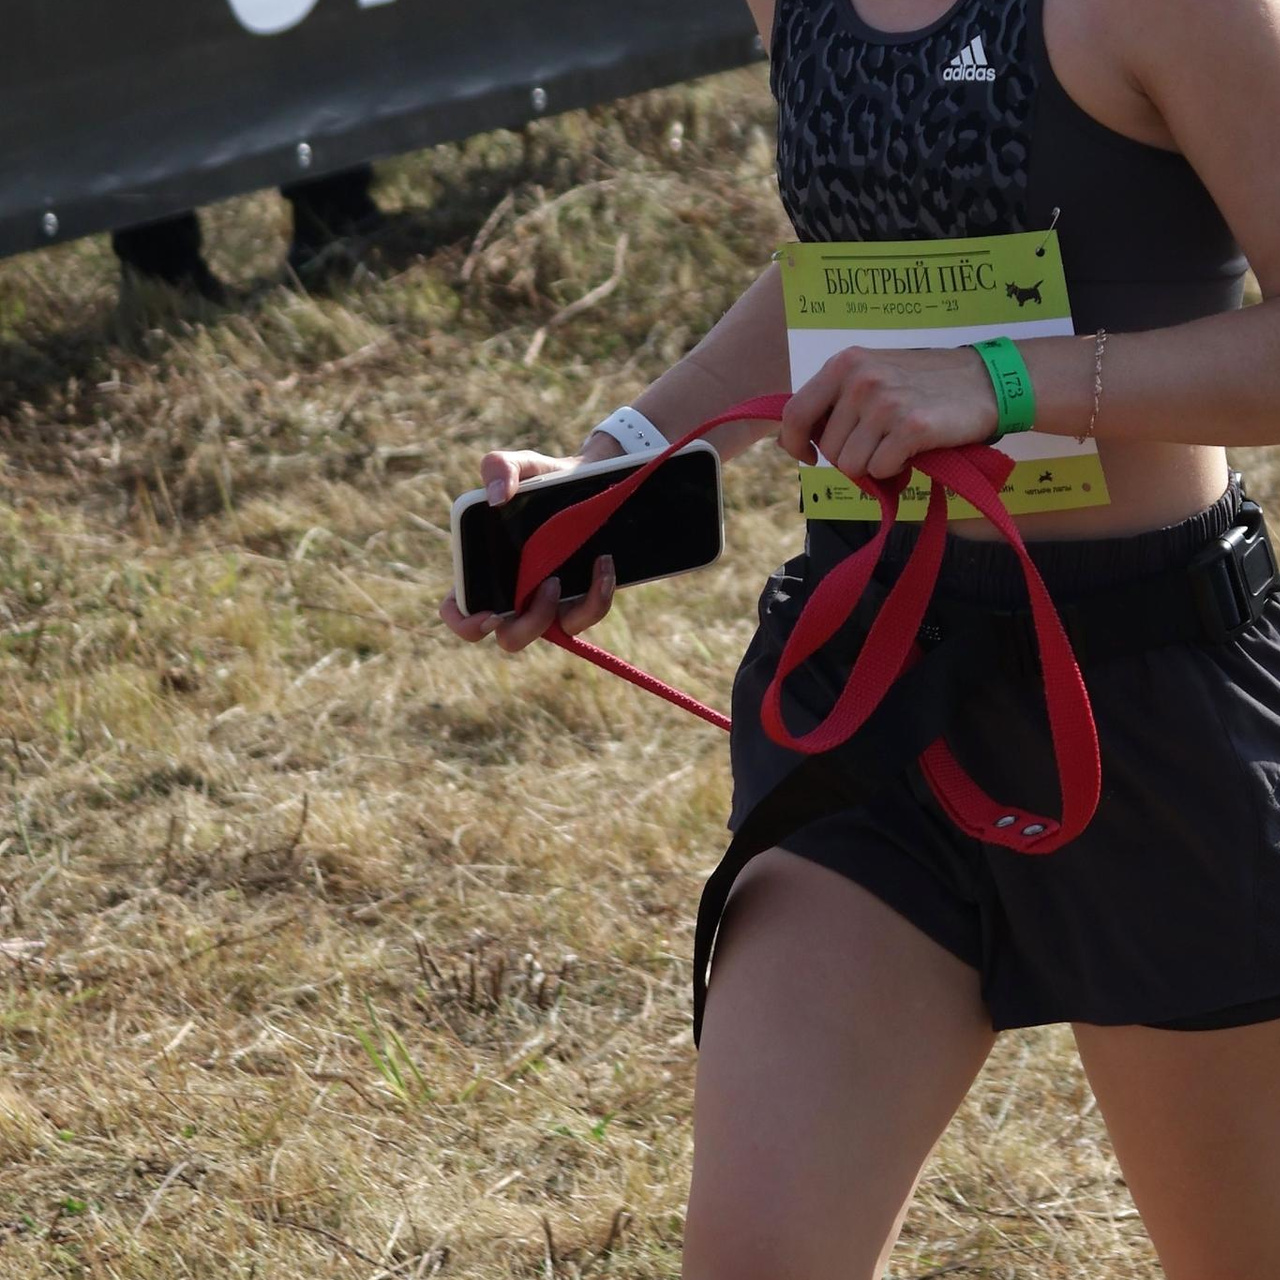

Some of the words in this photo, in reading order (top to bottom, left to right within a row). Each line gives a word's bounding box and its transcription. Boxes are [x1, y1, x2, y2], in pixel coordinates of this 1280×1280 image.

[942, 63, 996, 82] adidas
[824, 260, 932, 295] БЫСТРЫЙ
[937, 259, 997, 293] ПЁС
[799, 294, 808, 314] 2
[883, 302, 923, 315] КРОСС
[1002, 370, 1025, 399] 173
